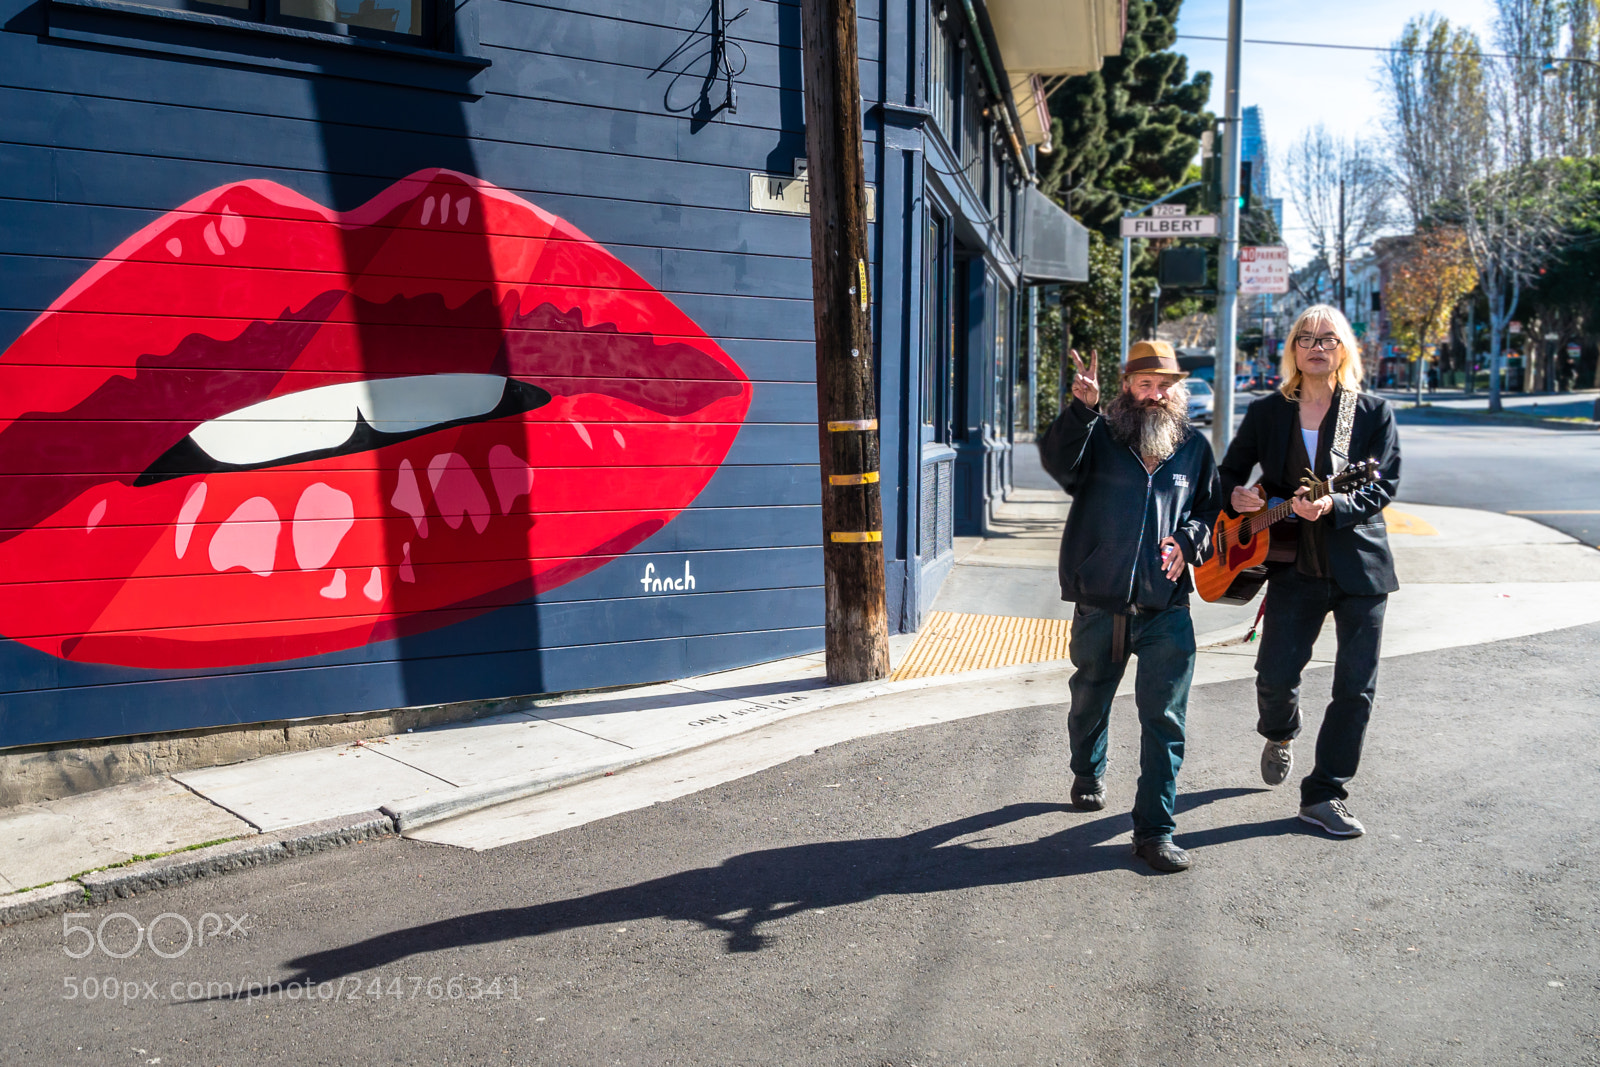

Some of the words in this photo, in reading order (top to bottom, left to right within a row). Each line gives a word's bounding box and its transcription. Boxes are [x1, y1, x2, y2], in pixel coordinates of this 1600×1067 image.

[1156, 205, 1175, 215] 720
[1134, 219, 1203, 233] FILBERT
[1241, 249, 1255, 262] NO
[1256, 250, 1287, 261] PARKING
[640, 560, 696, 592] fnnch
